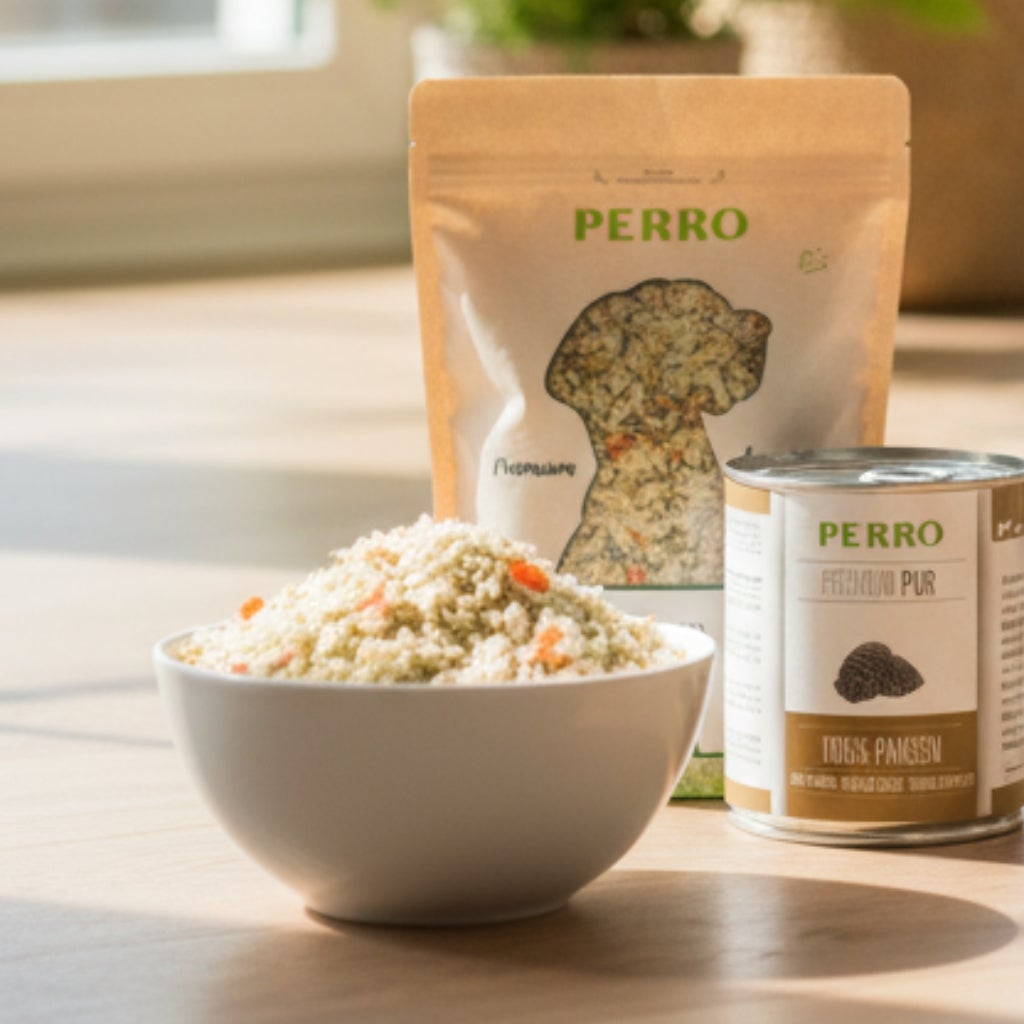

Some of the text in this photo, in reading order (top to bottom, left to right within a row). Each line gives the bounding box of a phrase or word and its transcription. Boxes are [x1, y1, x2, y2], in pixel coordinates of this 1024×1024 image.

[575, 207, 748, 242] PERRO
[819, 519, 944, 548] PERRO
[901, 569, 936, 596] PUR
